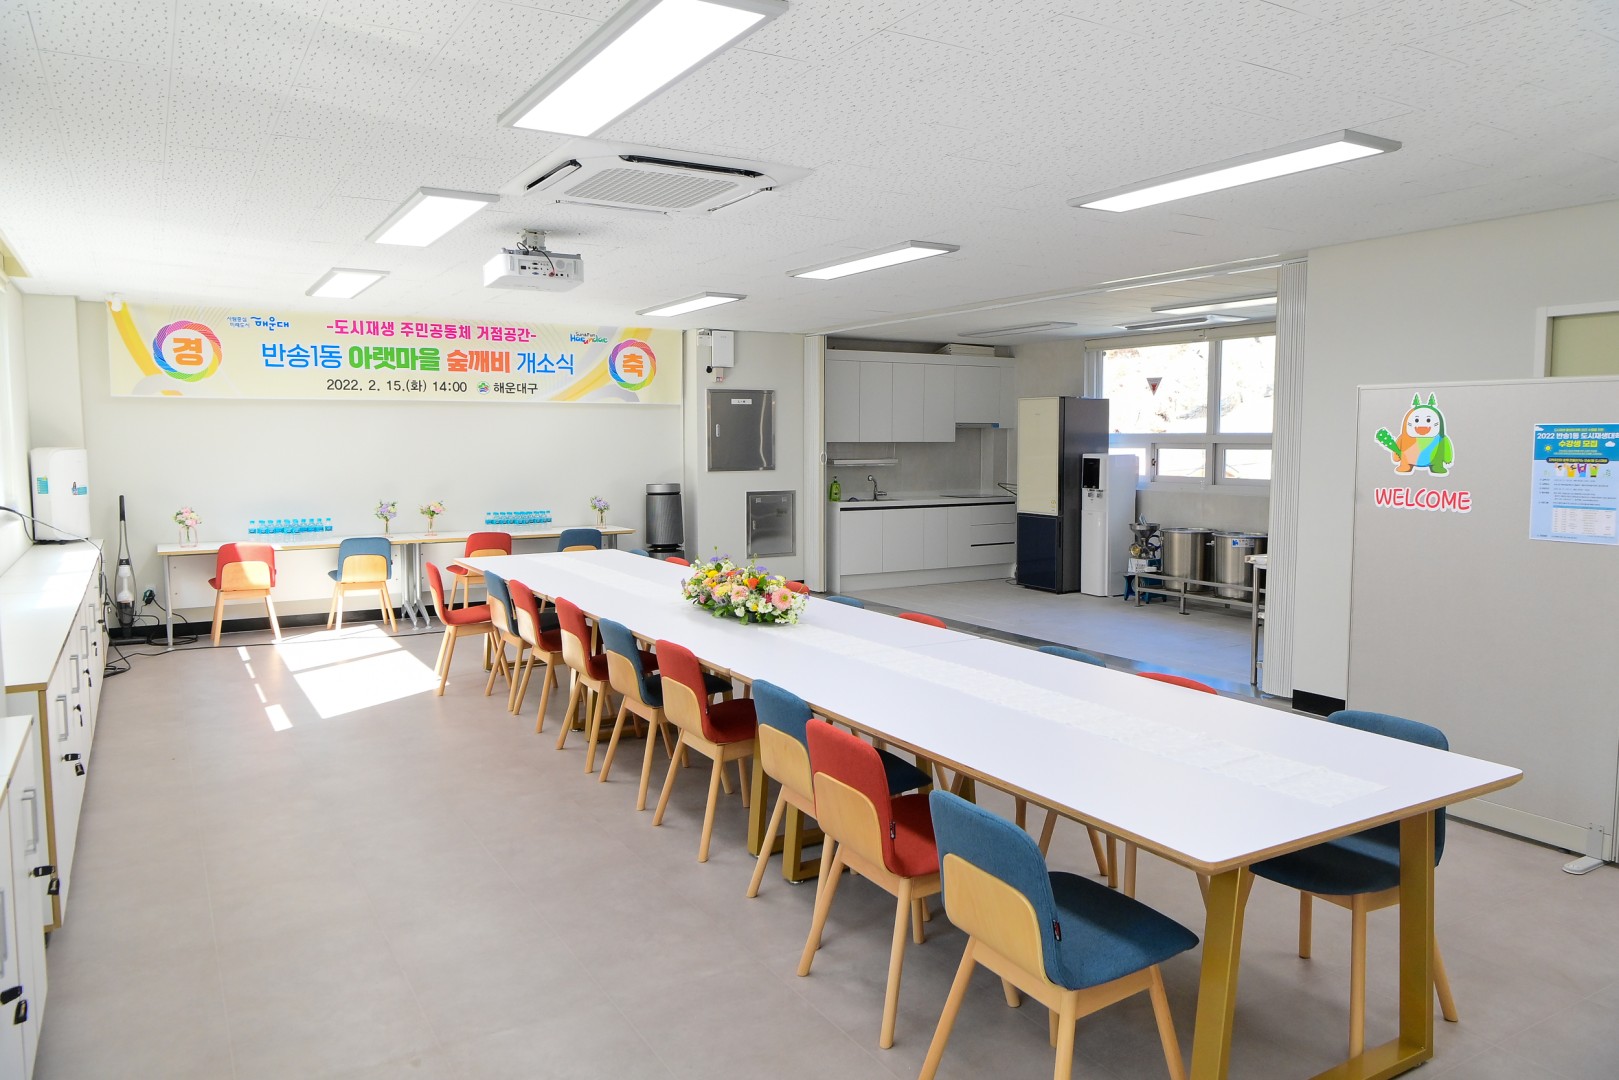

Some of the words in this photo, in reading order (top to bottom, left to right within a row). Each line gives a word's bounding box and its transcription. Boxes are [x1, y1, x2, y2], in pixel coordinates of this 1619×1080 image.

[251, 316, 290, 331] 해운대
[326, 319, 395, 336] -도시재생
[400, 322, 471, 339] 주민공동체
[477, 325, 536, 342] 거점공간-
[172, 337, 204, 366] 경
[261, 343, 342, 369] 반송1동
[348, 345, 440, 371] 아랫마을
[446, 349, 511, 374] 숲깨비
[517, 352, 574, 375] 개소식
[622, 354, 643, 377] 축
[326, 379, 363, 391] 2022.
[368, 379, 381, 391] 2.
[386, 379, 427, 393] 15.(화)
[432, 381, 468, 392] 14:00
[493, 382, 538, 394] 해운대구
[1375, 488, 1471, 510] WELCOME
